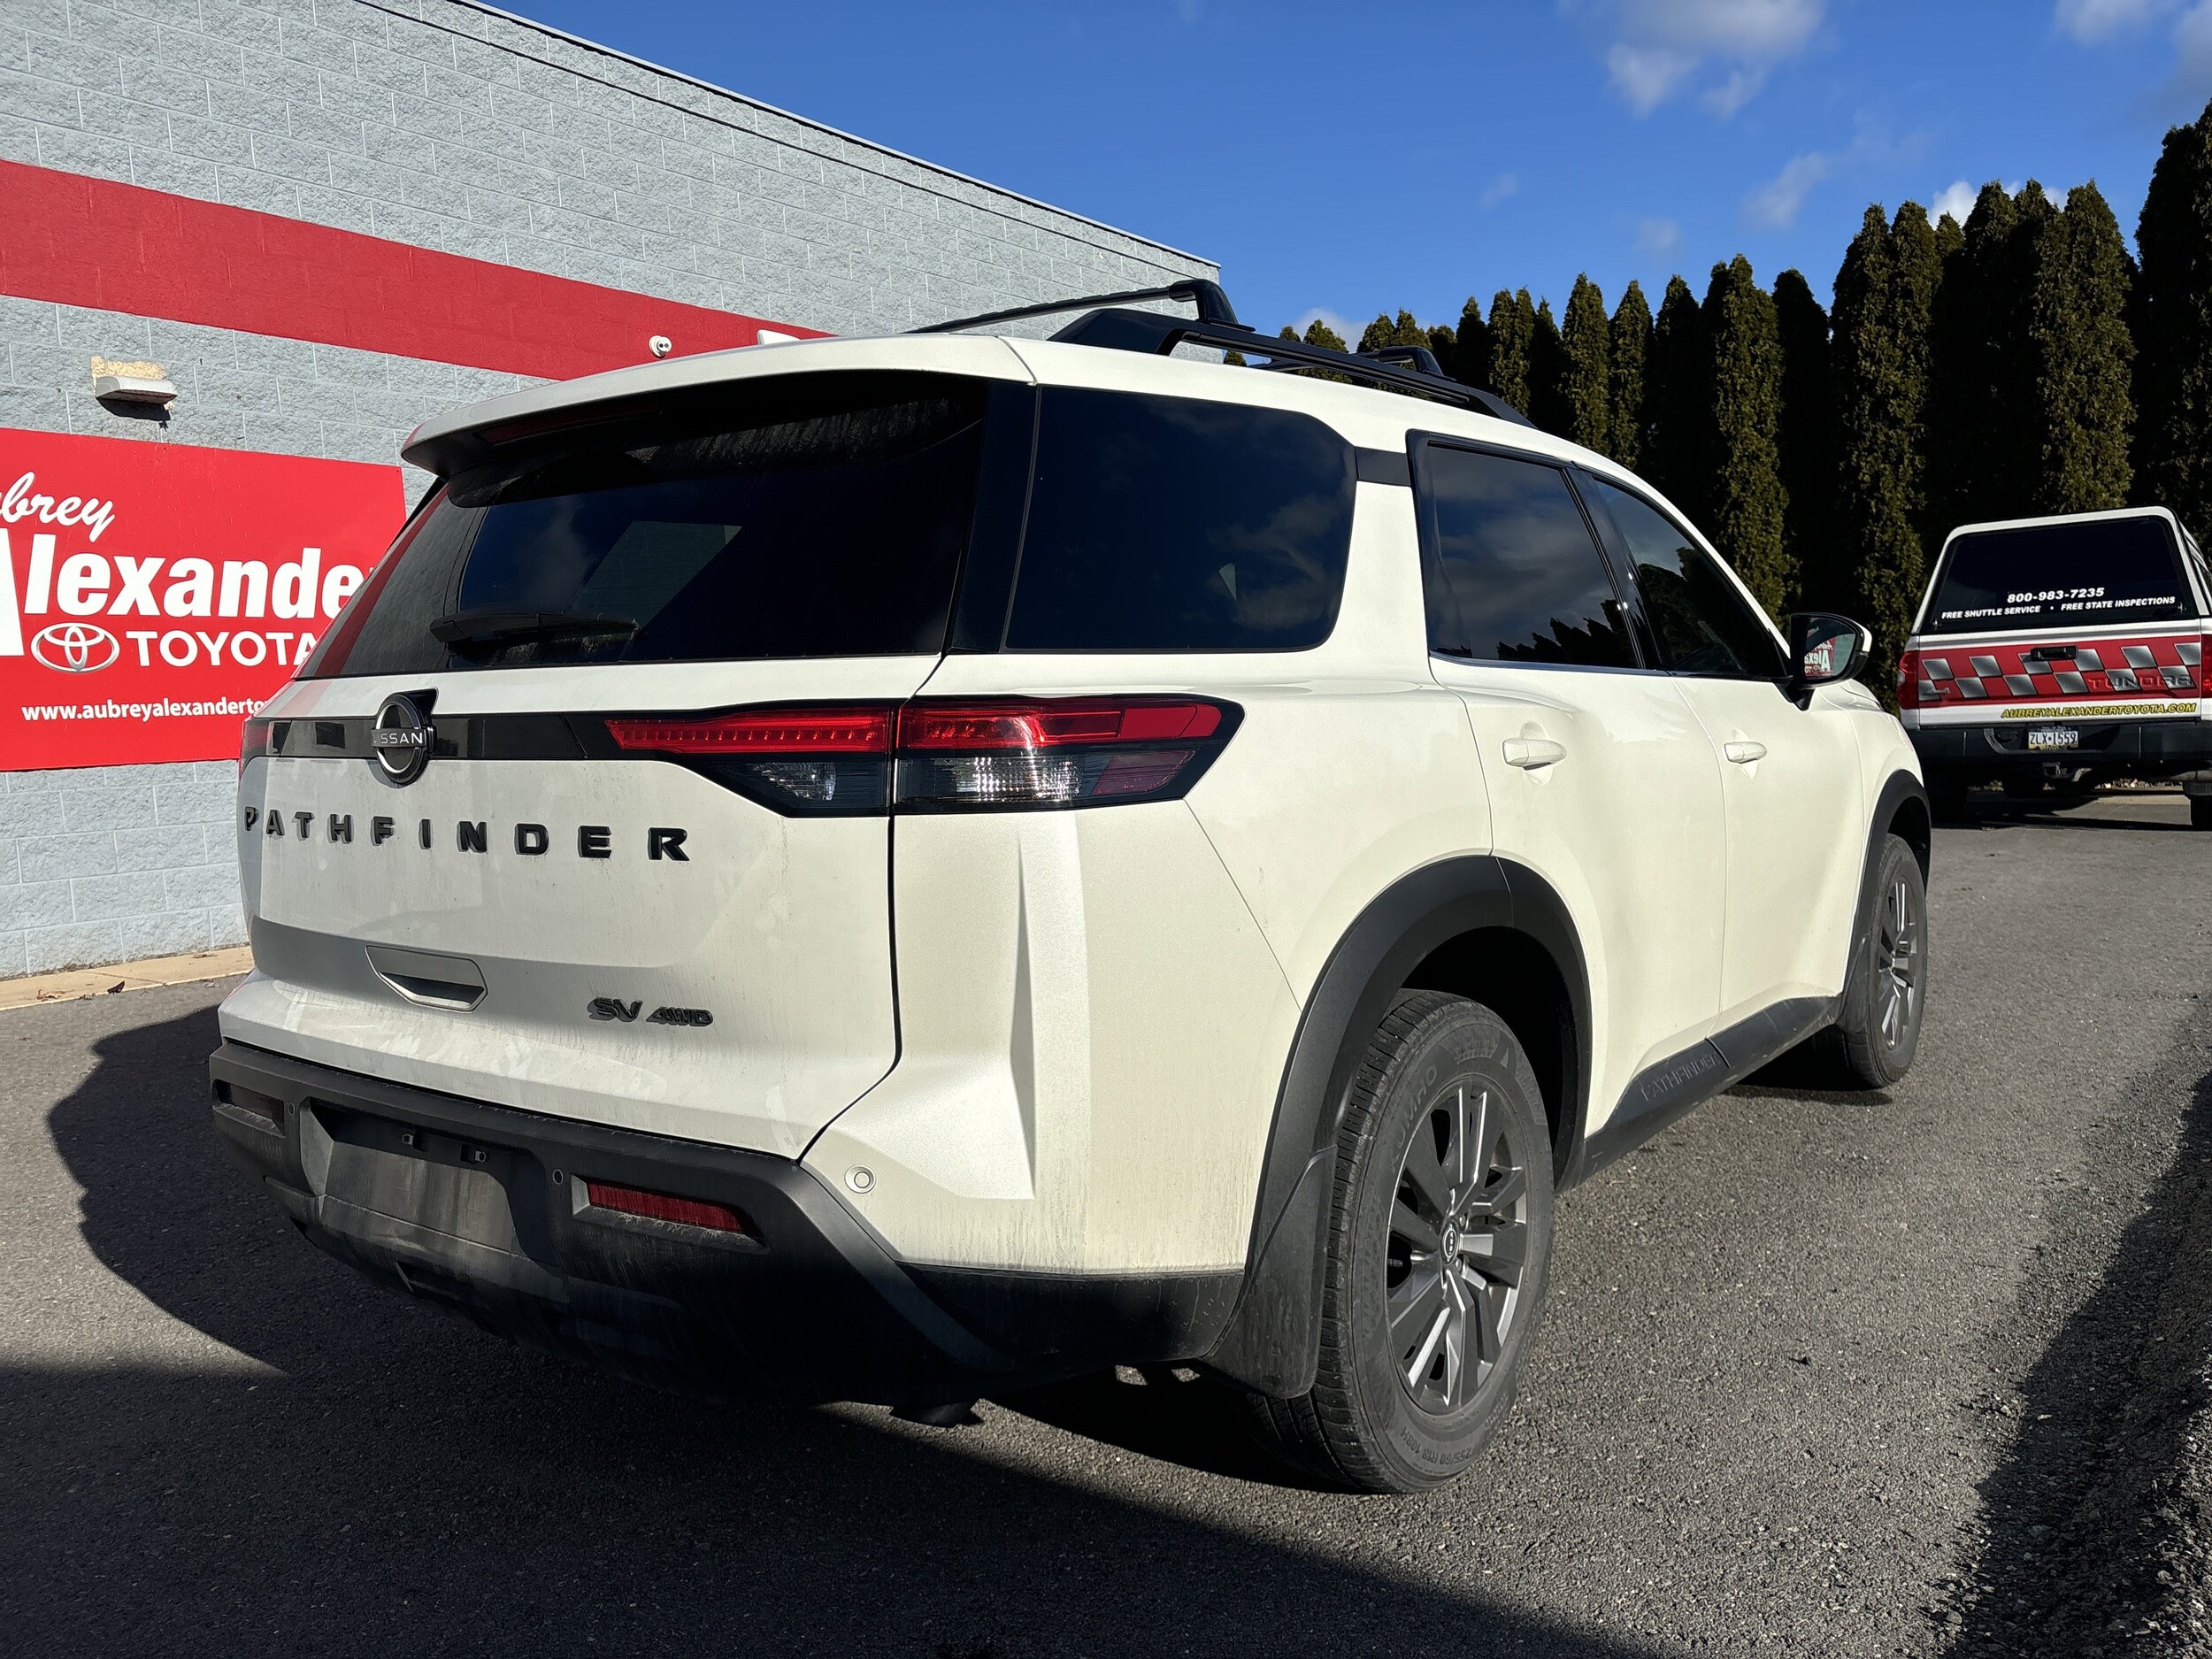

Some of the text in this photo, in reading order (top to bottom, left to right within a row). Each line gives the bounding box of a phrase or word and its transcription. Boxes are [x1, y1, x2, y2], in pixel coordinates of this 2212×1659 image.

[0, 471, 116, 543] brey
[1941, 611, 1962, 619] FREE
[1964, 608, 2002, 618] SHUTTLE
[2004, 605, 2041, 615] SERVICE
[2085, 601, 2113, 610] STATE
[2115, 596, 2176, 608] INSPECTIONS
[2007, 588, 2105, 603] 800-983-7235
[2088, 675, 2193, 690] TUNDRA
[21, 695, 268, 723] www.aubreyalexanderto
[2001, 703, 2197, 718] AUBREYALEXANDERTOYOTA.COM
[244, 806, 690, 861] PATHFINDER
[587, 997, 643, 1022] SV
